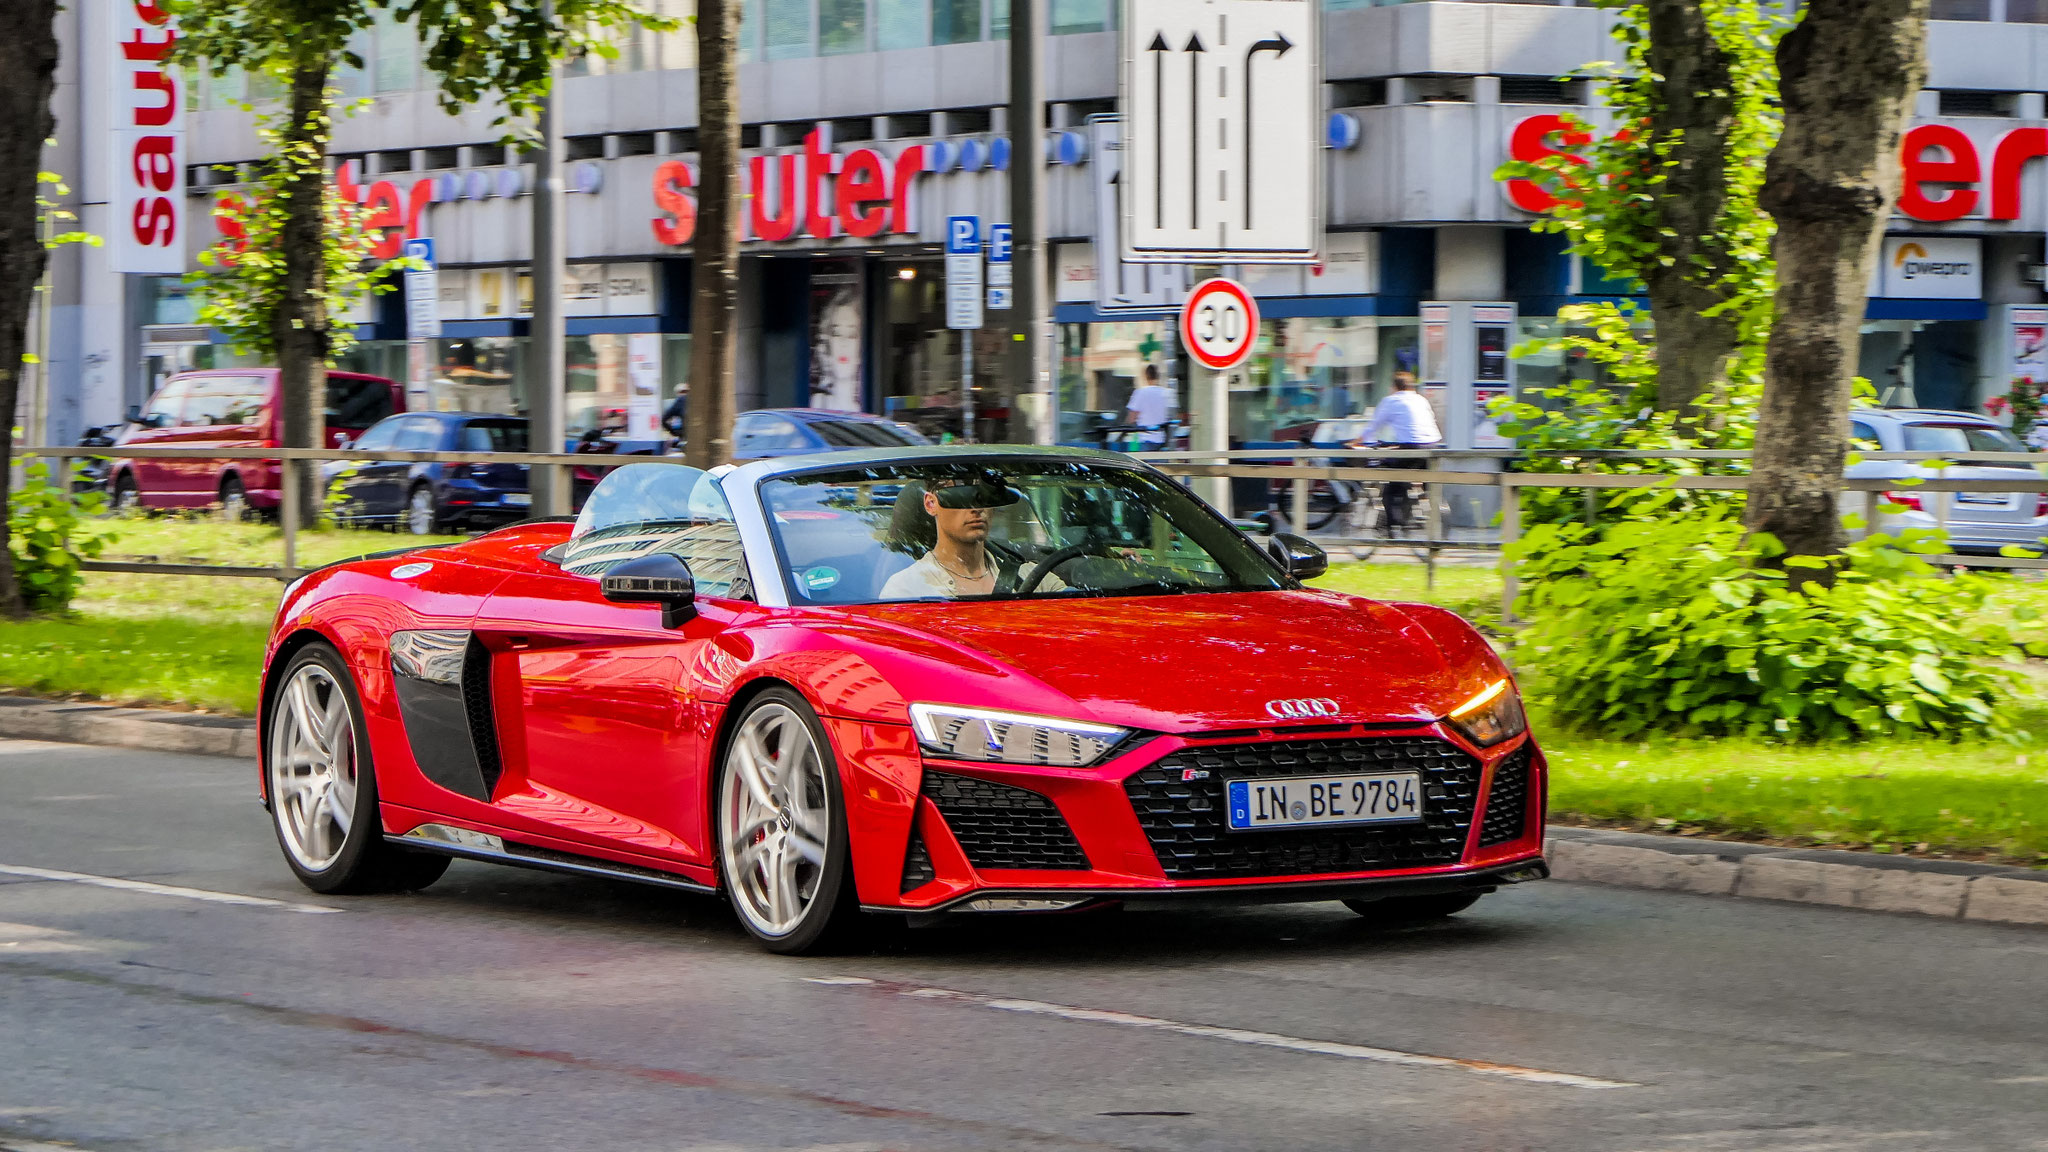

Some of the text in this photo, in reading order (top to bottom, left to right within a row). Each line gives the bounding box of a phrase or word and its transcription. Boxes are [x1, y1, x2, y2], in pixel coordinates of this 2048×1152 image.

[651, 127, 924, 246] suter
[215, 160, 433, 267] ster
[952, 220, 975, 249] P
[1197, 305, 1239, 343] 30
[1236, 808, 1245, 819] D
[1256, 779, 1416, 821] IN BE 9784
